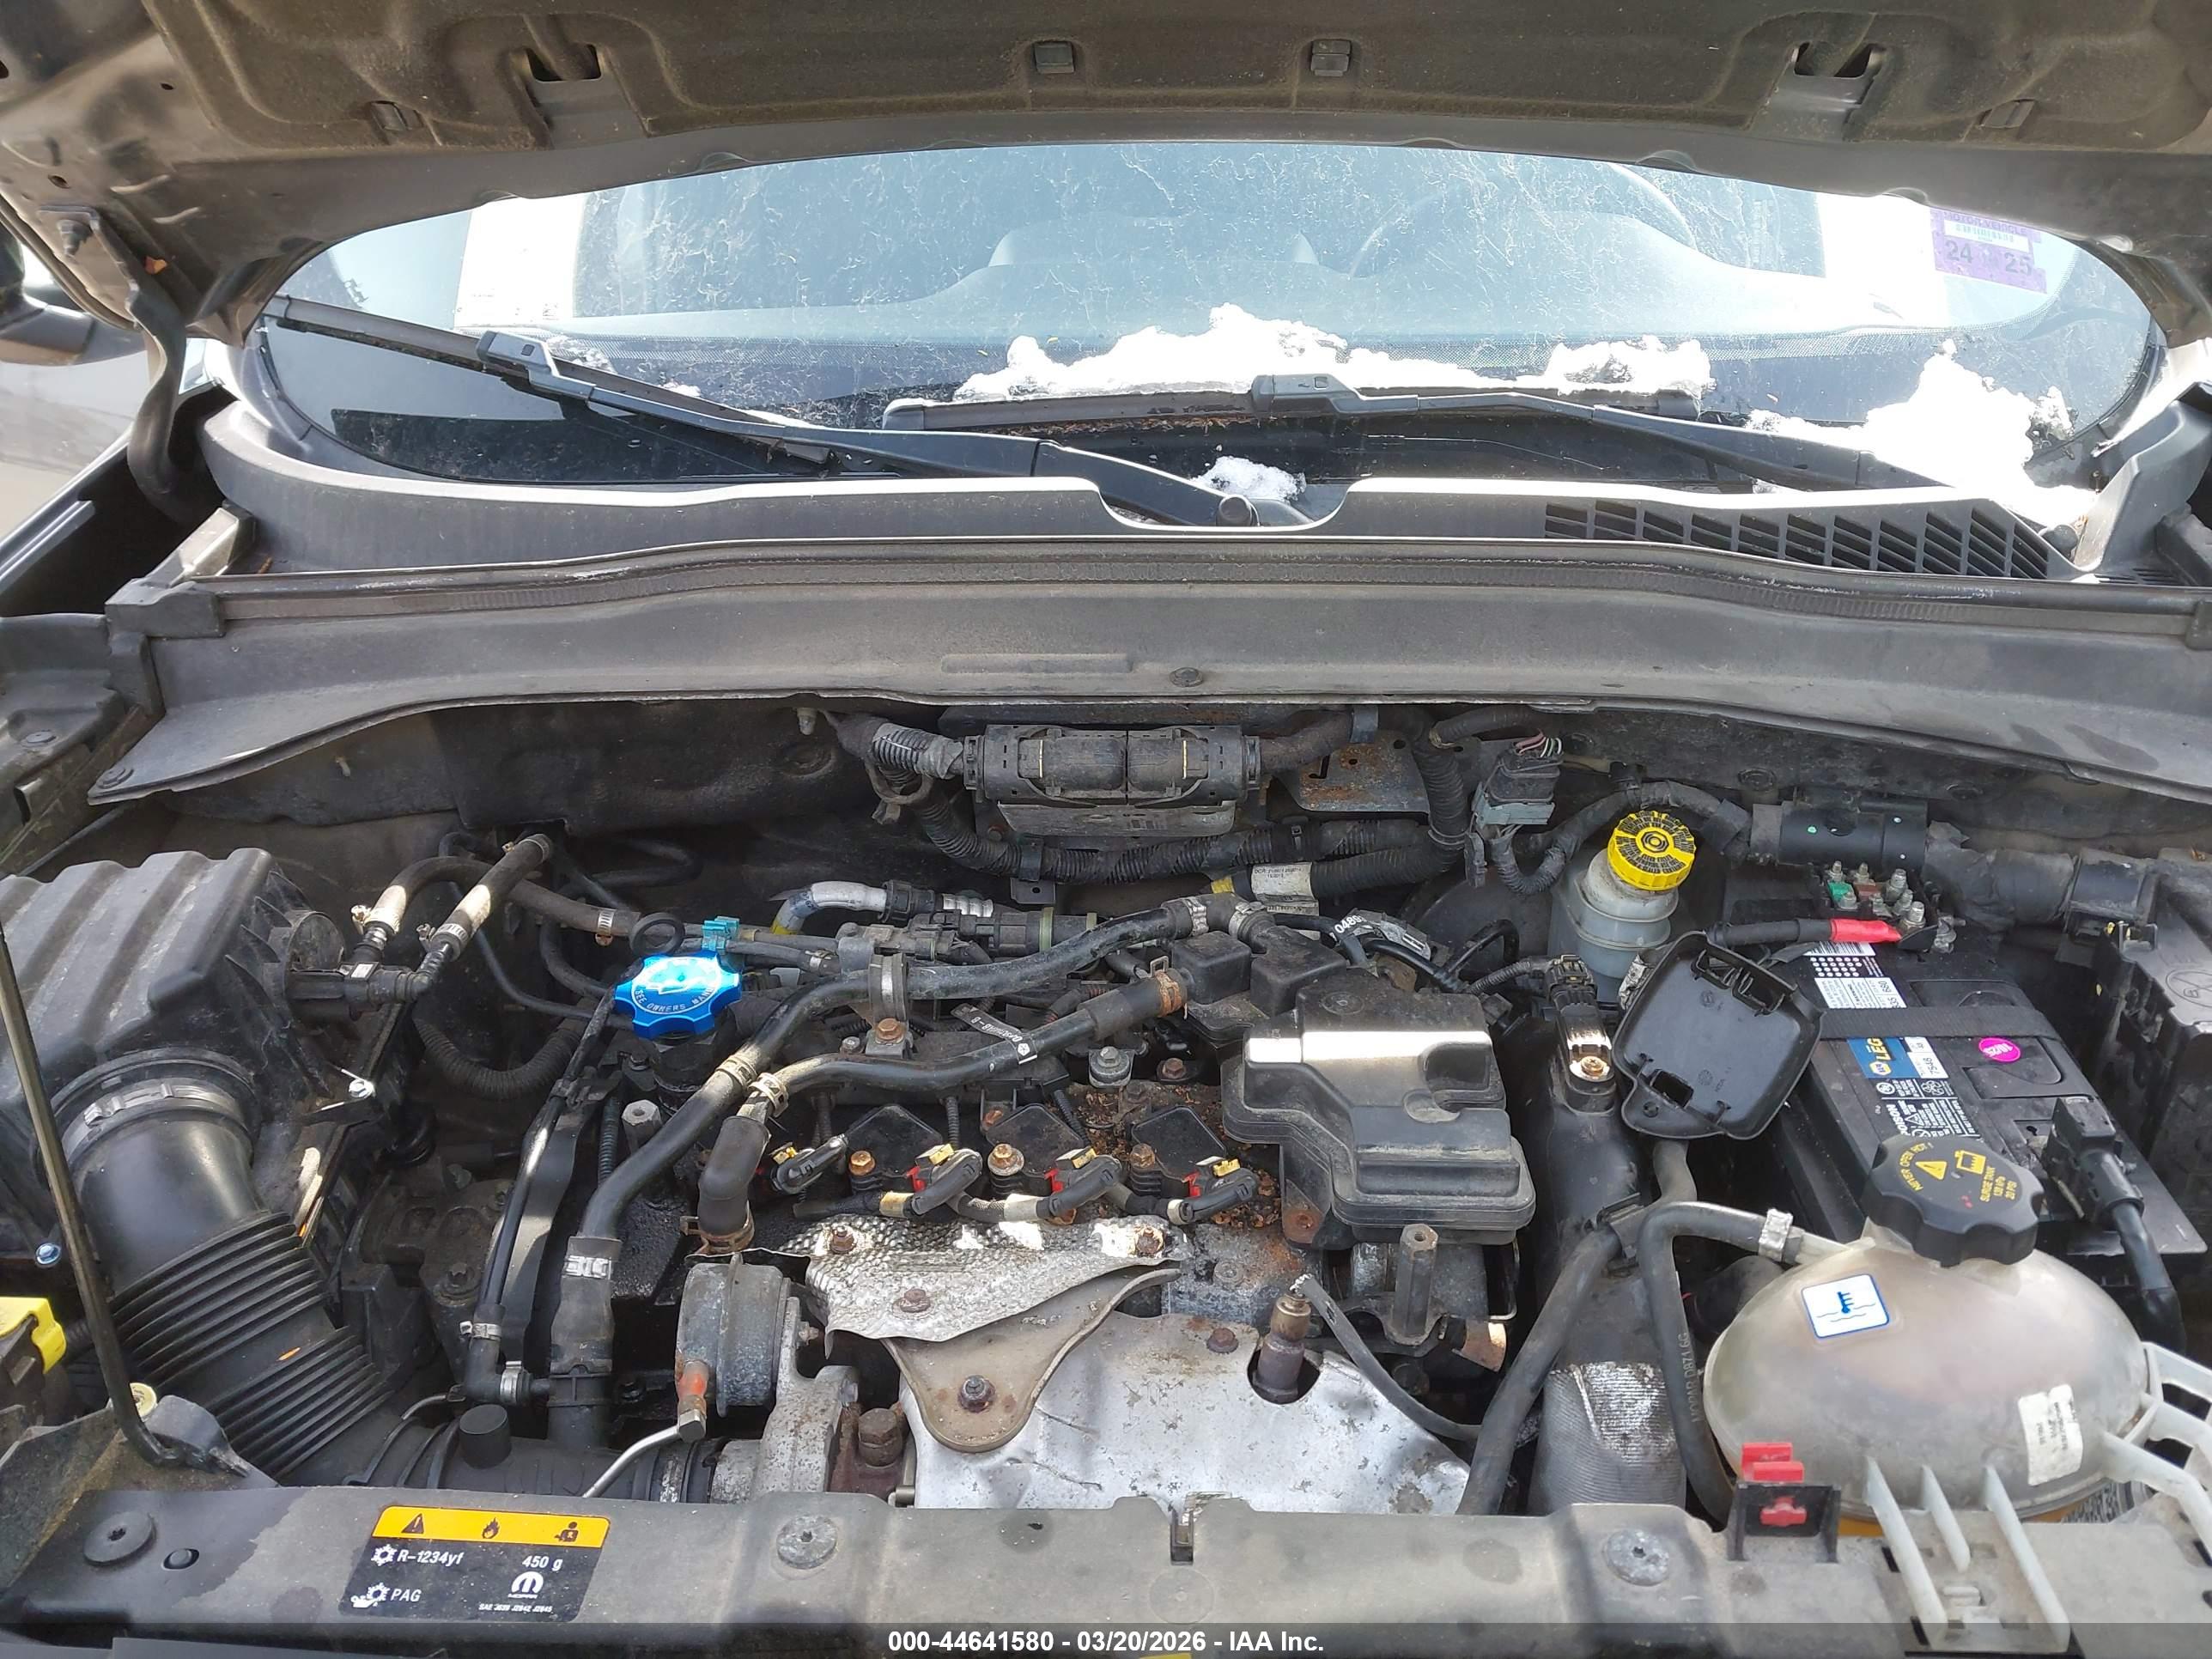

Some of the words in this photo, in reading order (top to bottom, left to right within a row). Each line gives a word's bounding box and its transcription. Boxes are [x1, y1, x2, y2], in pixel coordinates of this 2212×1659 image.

[1946, 240, 1973, 264] 24
[2005, 252, 2032, 276] 25
[635, 988, 647, 1004] SEE
[647, 1002, 686, 1012] OWNERS
[1886, 1103, 1911, 1135] POISON
[1899, 1151, 1914, 1168] OPEN
[1901, 1169, 1923, 1191] NEVER
[397, 1549, 465, 1567] R-1234yf
[521, 1555, 550, 1569] 450
[551, 1558, 563, 1571] g
[390, 1589, 422, 1602] PAG
